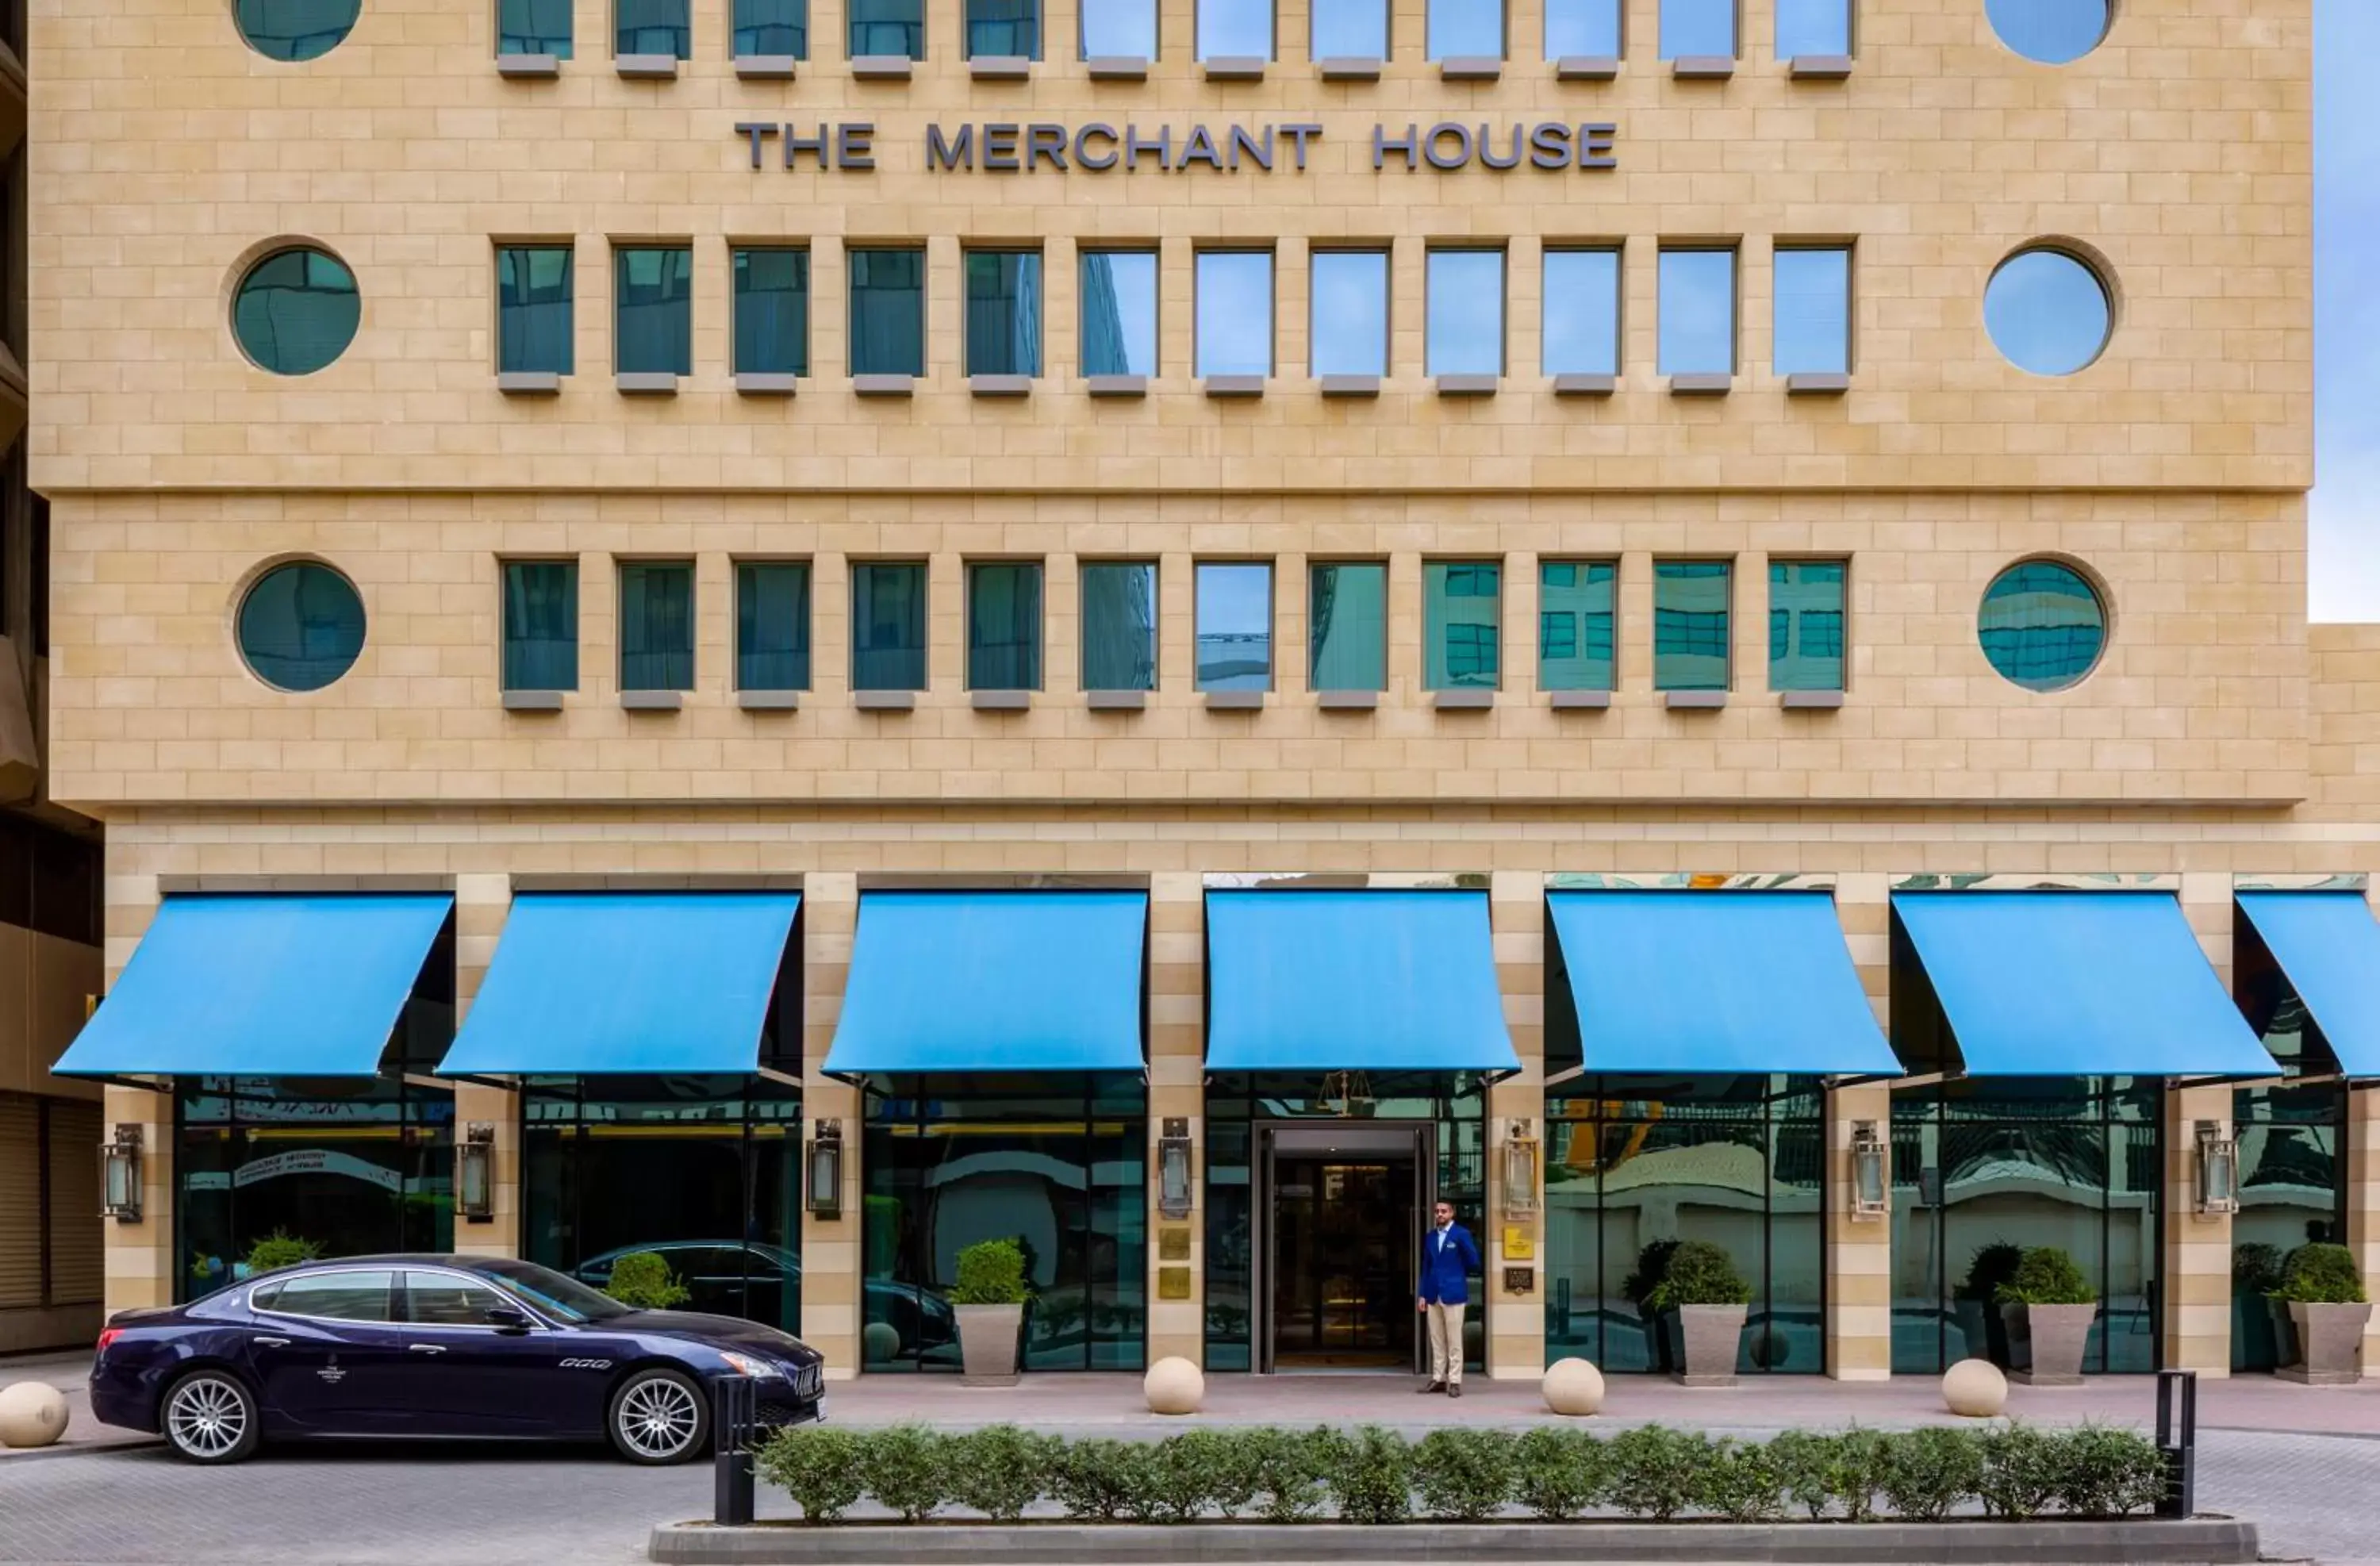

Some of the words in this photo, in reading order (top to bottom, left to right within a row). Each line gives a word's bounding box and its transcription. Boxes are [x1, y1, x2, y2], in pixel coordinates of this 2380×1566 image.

[735, 123, 875, 171] THE
[927, 123, 1322, 171] MERCHANT
[1373, 122, 1618, 171] HOUSE
